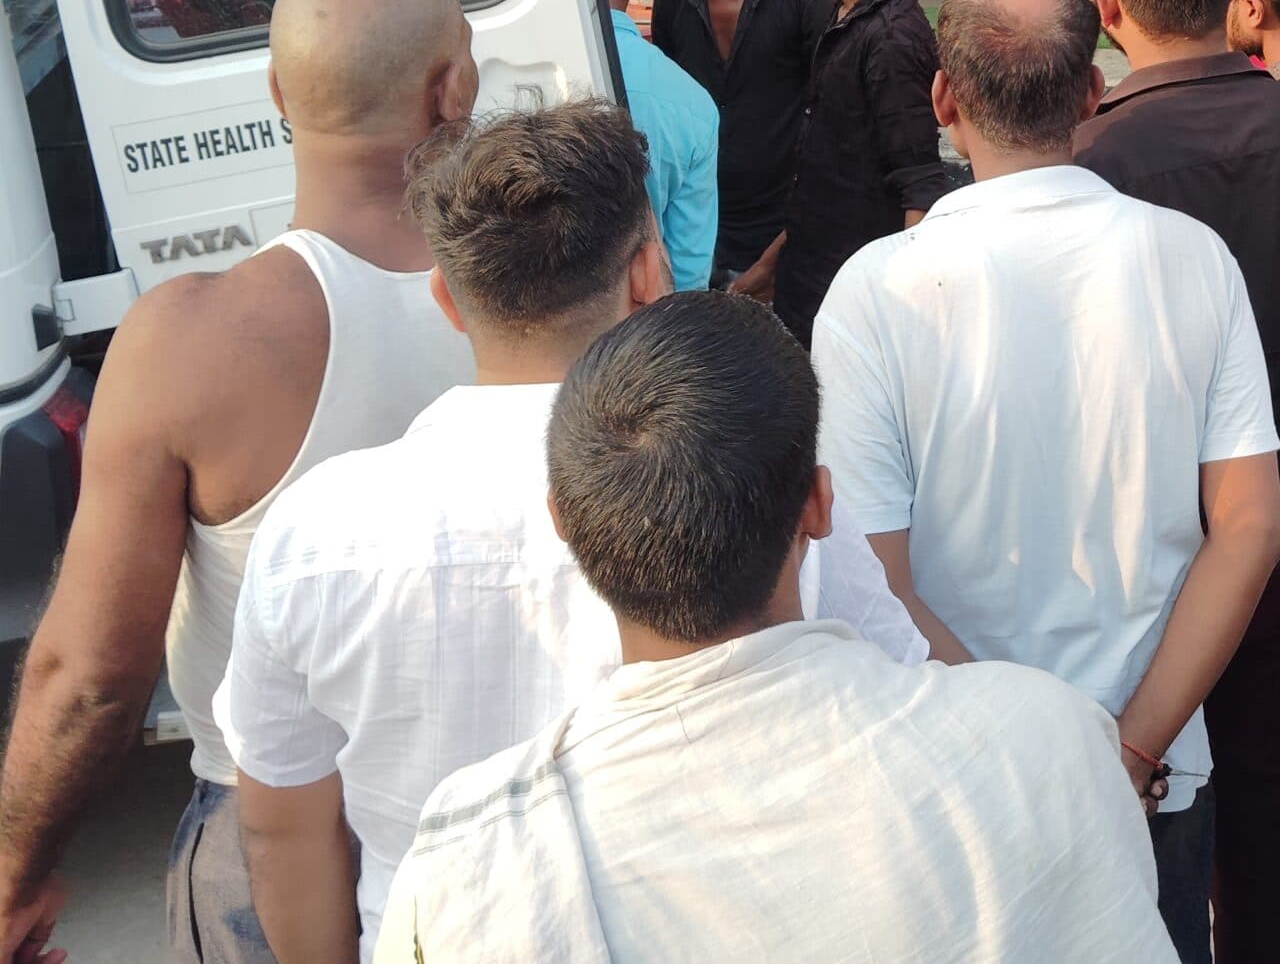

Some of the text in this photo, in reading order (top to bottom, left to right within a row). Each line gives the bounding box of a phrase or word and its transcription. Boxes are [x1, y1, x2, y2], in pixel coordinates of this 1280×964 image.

[124, 135, 190, 173] STATE
[193, 119, 275, 160] HEALTH
[140, 224, 253, 265] TATA
